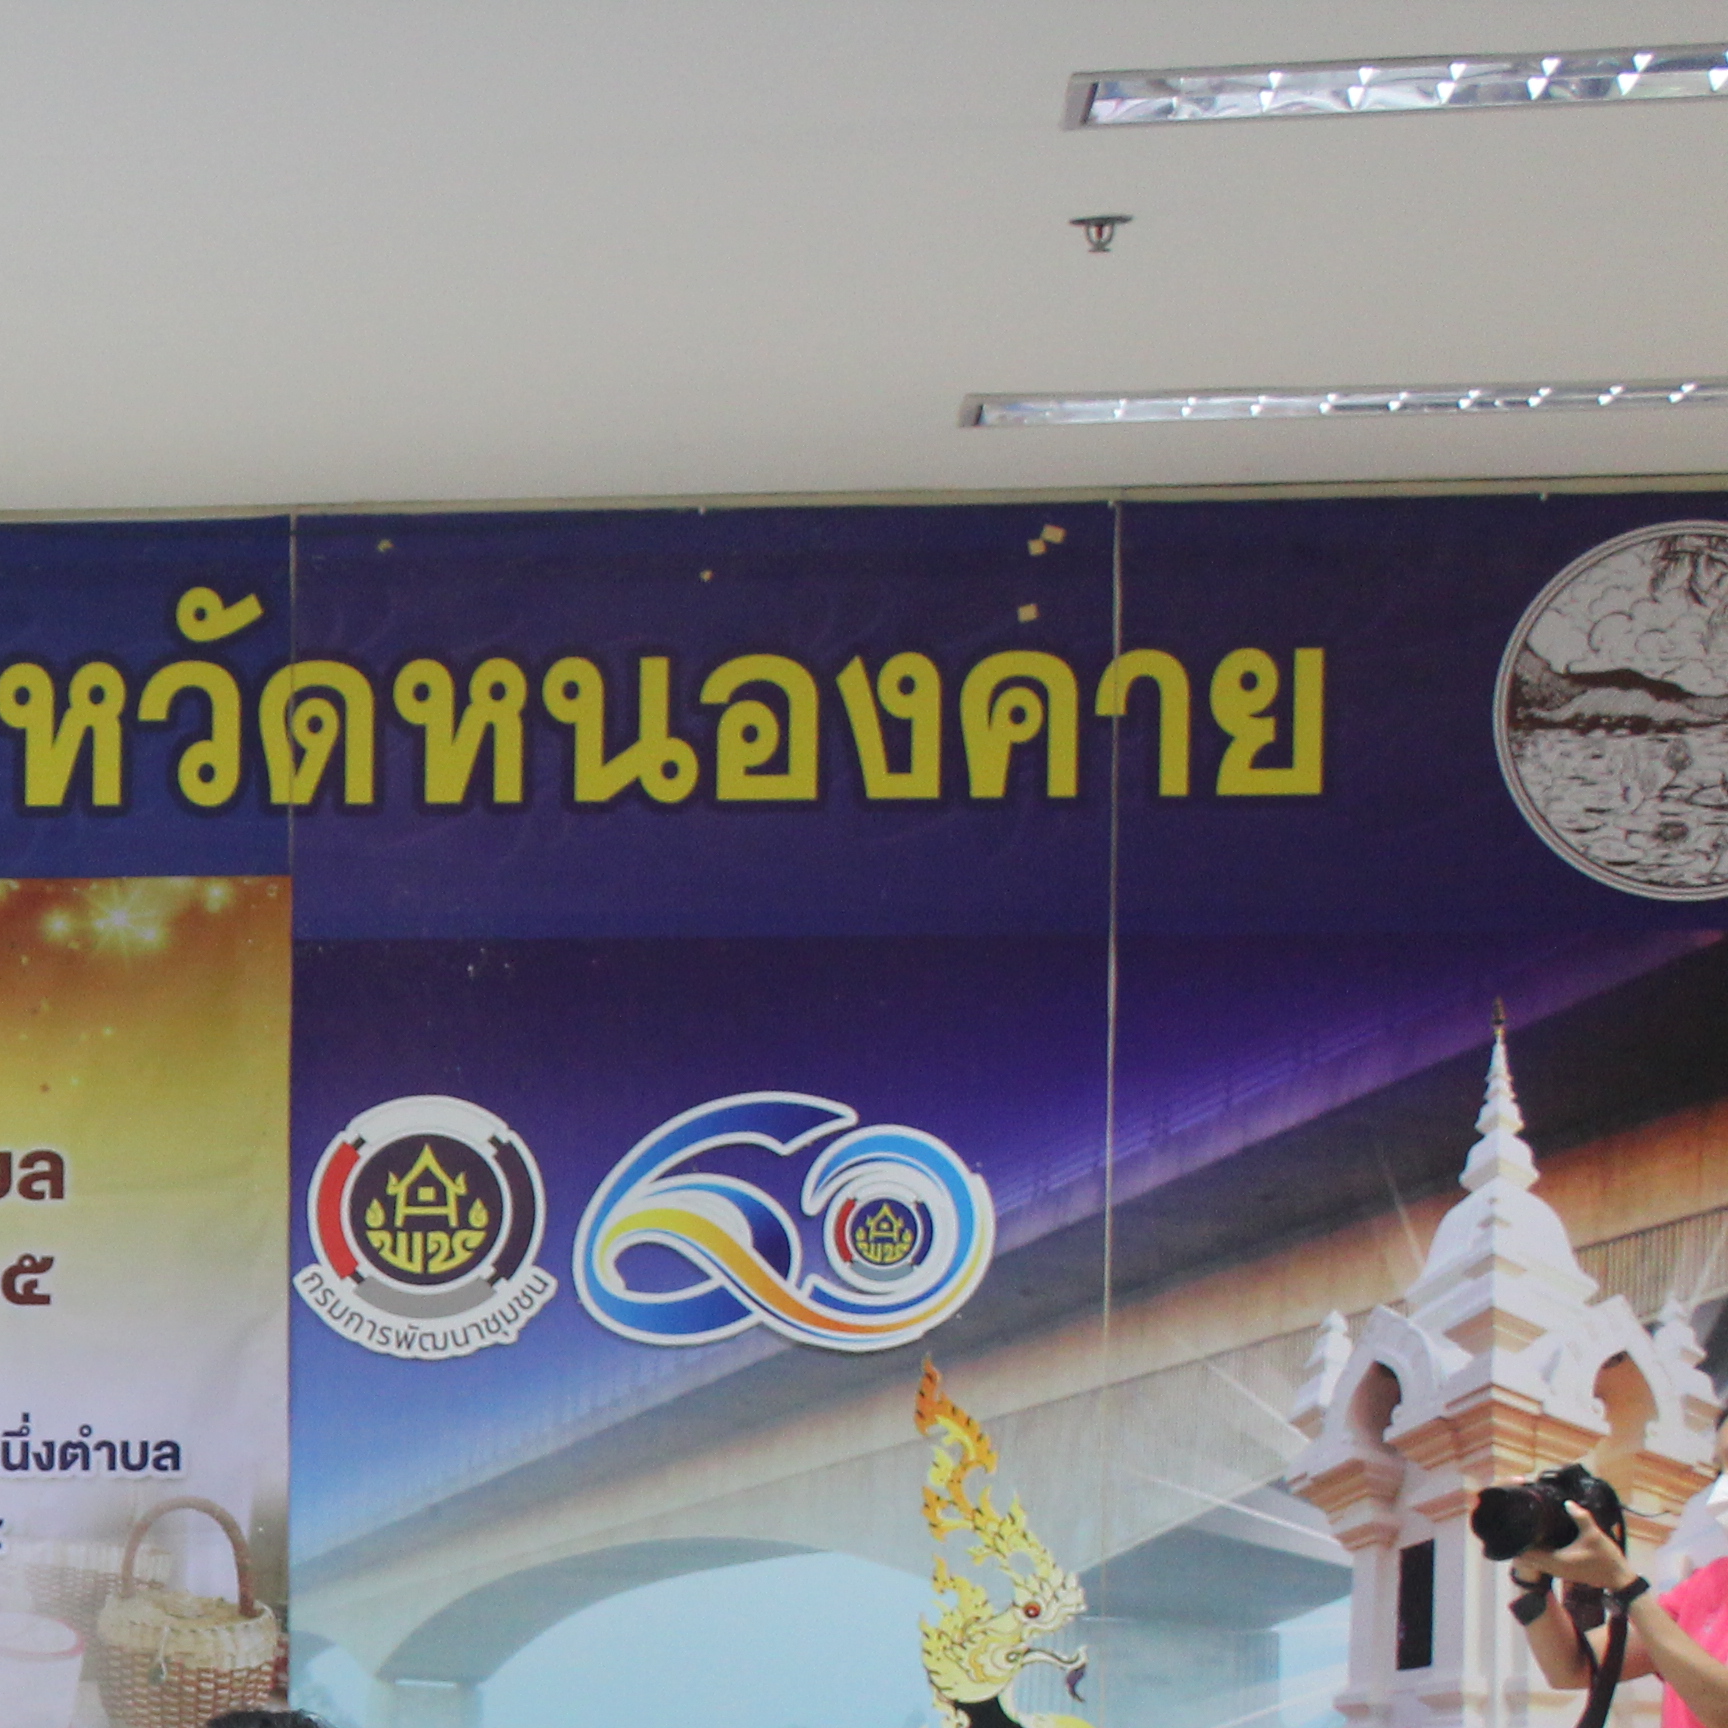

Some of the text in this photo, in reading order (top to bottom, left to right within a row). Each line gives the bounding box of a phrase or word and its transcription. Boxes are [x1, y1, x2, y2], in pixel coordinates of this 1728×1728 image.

[302, 1272, 550, 1352] กรมการพัฒนาชุมชน
